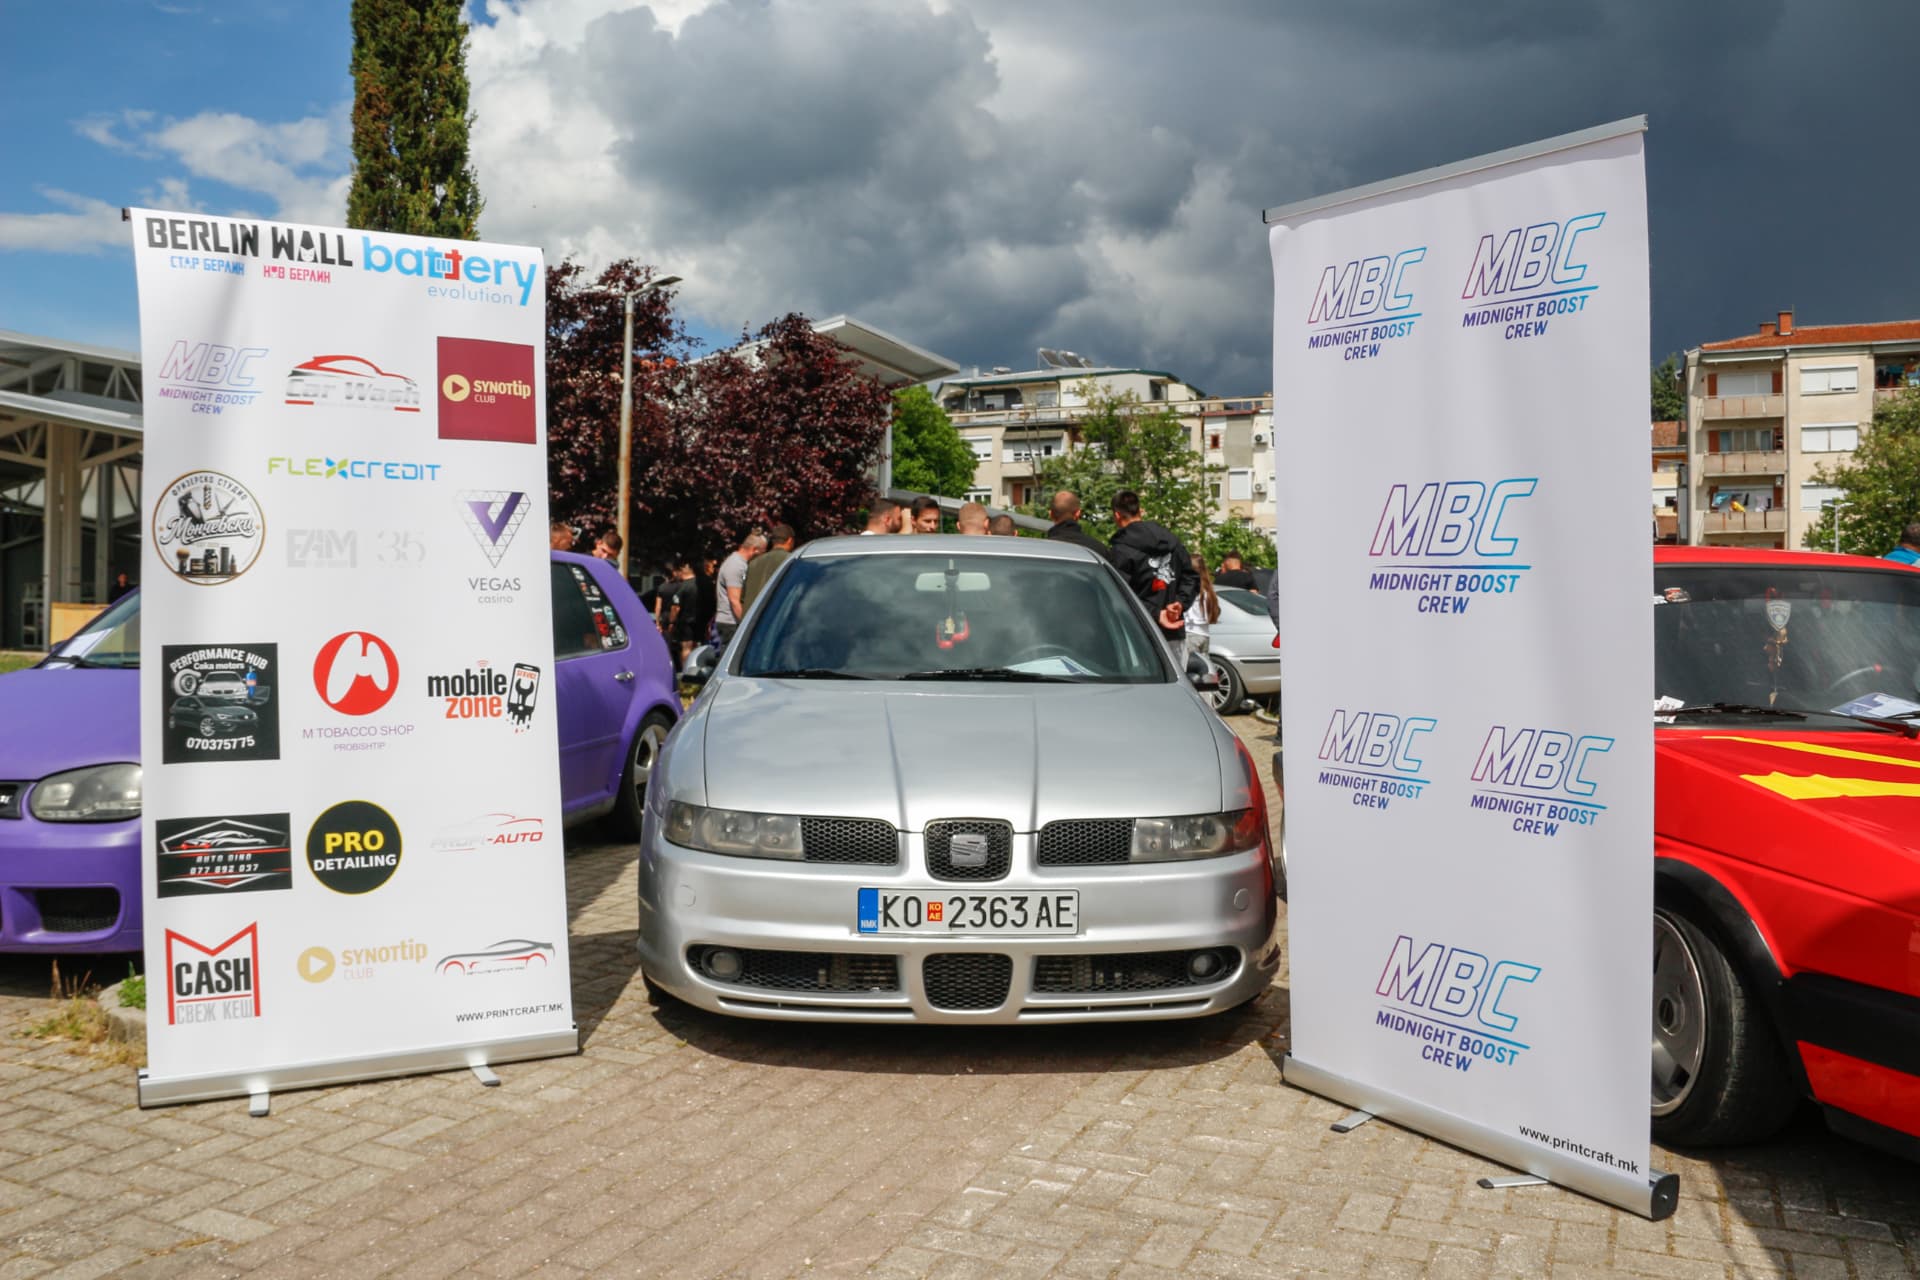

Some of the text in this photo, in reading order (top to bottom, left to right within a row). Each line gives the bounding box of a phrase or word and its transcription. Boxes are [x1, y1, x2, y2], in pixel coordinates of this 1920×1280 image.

[146, 217, 353, 267] BERLIN WALL
[203, 258, 245, 276] БЕРЛИН
[1462, 212, 1606, 299] MBC
[289, 268, 331, 284] БЕРЛИН
[362, 236, 537, 306] battery
[427, 283, 513, 305] evolution
[1307, 247, 1427, 324] MBC
[1462, 295, 1589, 328] MIDNIGHT BOOST
[1308, 321, 1415, 349] MIDNIGHT BOOST
[1505, 320, 1548, 340] CREW
[159, 340, 269, 387] MBC
[1344, 343, 1381, 361] CREW
[159, 388, 255, 405] MIDNIGHT BOOST
[474, 394, 496, 404] CLUB
[192, 402, 223, 415] CREW
[1369, 478, 1539, 556] MBC
[468, 577, 521, 592] VEGAS
[1369, 573, 1520, 593] MIDNIGHT BOOST
[478, 593, 513, 604] casino
[1418, 595, 1469, 614] CREW
[169, 648, 269, 673] PERFORMANCE HUB
[215, 662, 245, 670] motors
[427, 668, 507, 697] mobile
[445, 696, 503, 719] zone
[186, 735, 256, 751] 070375775
[302, 724, 415, 740] M TOBACCO SHOP
[1318, 709, 1438, 773] MBC
[333, 742, 386, 752] PROBISHTIP
[1470, 726, 1615, 797] MBC
[1318, 771, 1423, 799] MIDNIGHT BOOST
[1352, 792, 1390, 810] CREW
[1470, 794, 1599, 826] MIDNIGHT BOOST
[1512, 817, 1560, 837] CREW
[325, 829, 385, 854] PRO
[313, 854, 397, 872] DETAILING
[882, 895, 1074, 929] KO 2363 AE
[860, 920, 877, 929] NMK
[175, 957, 252, 997] CASH
[344, 967, 374, 980] CLUB
[1376, 935, 1542, 1033] MBC
[176, 999, 253, 1025] СВЕЖ КЕШ
[456, 1003, 564, 1023] WWW.PRINTCRAFT.MK
[1376, 1010, 1519, 1066] MIDNIGHT BOOST
[1421, 1044, 1473, 1072] CREW
[1519, 1124, 1640, 1175] www.printcraft.mk
